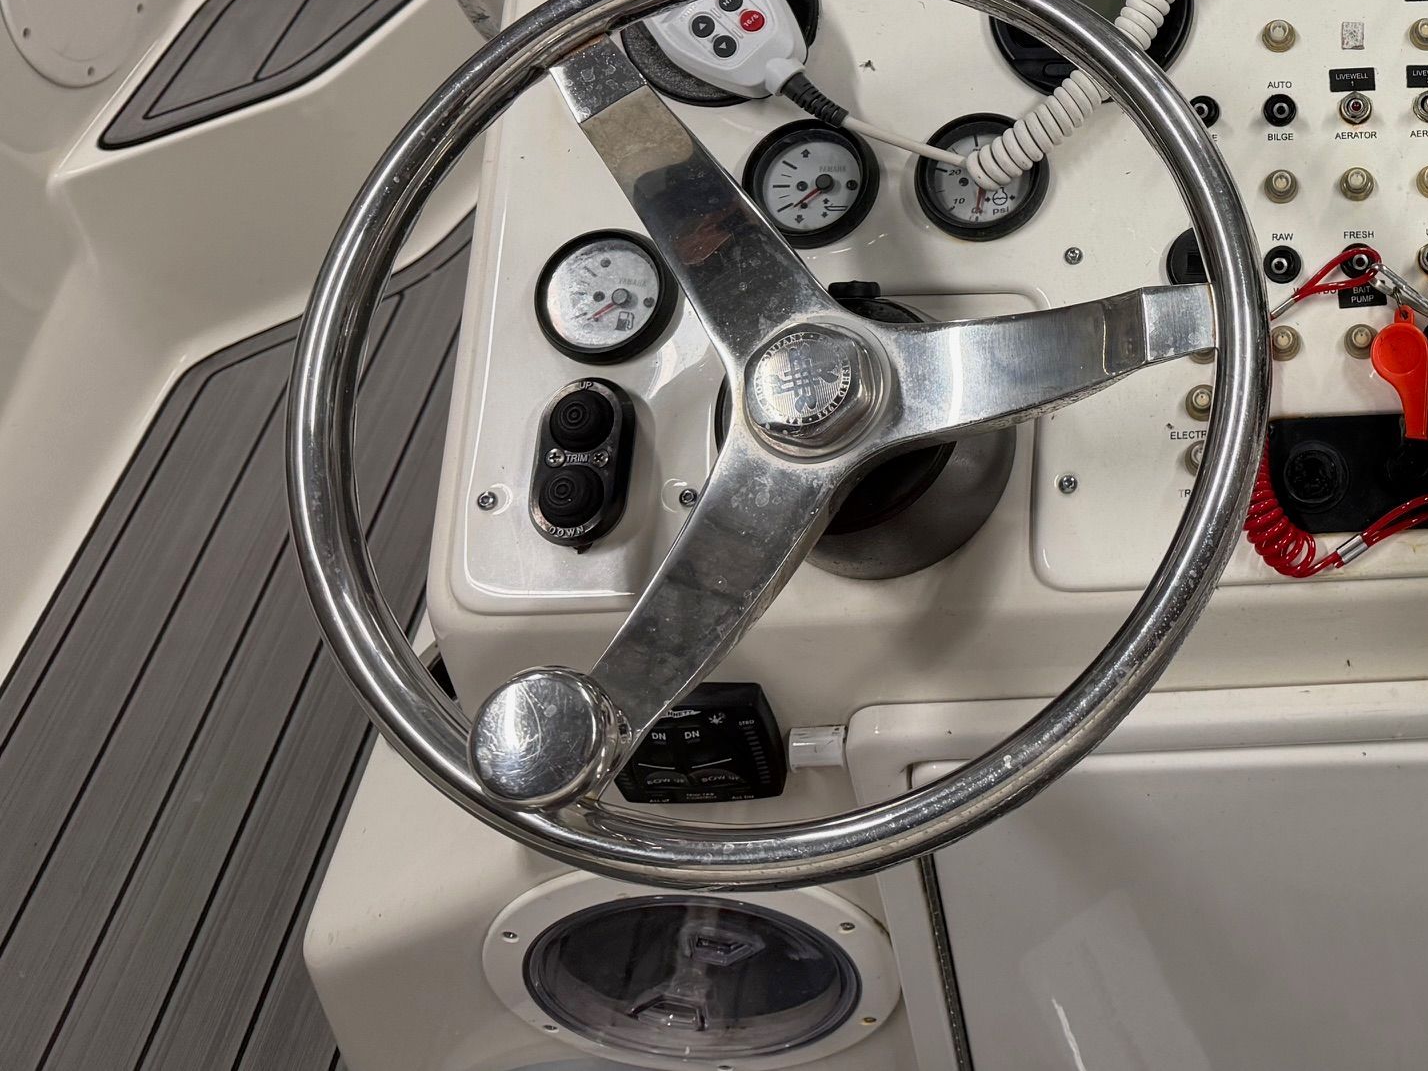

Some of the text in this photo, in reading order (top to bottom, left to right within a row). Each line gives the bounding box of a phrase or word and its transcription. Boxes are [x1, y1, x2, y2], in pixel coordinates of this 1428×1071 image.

[743, 13, 760, 26] 16/S
[1335, 73, 1369, 81] LIVEWELL
[1267, 81, 1293, 89] AUTO
[1267, 133, 1294, 141] BILGE
[1335, 131, 1378, 140] AERATOR
[992, 207, 1009, 215] psi
[1271, 233, 1294, 241] RAW
[1343, 231, 1375, 239] FRESH
[1352, 286, 1371, 294] BAIT
[1350, 295, 1375, 304] PUMP
[579, 381, 594, 391] UP
[565, 453, 589, 464] TRIM
[549, 526, 585, 538] DOWN
[651, 731, 667, 741] DN
[684, 730, 700, 740] DN
